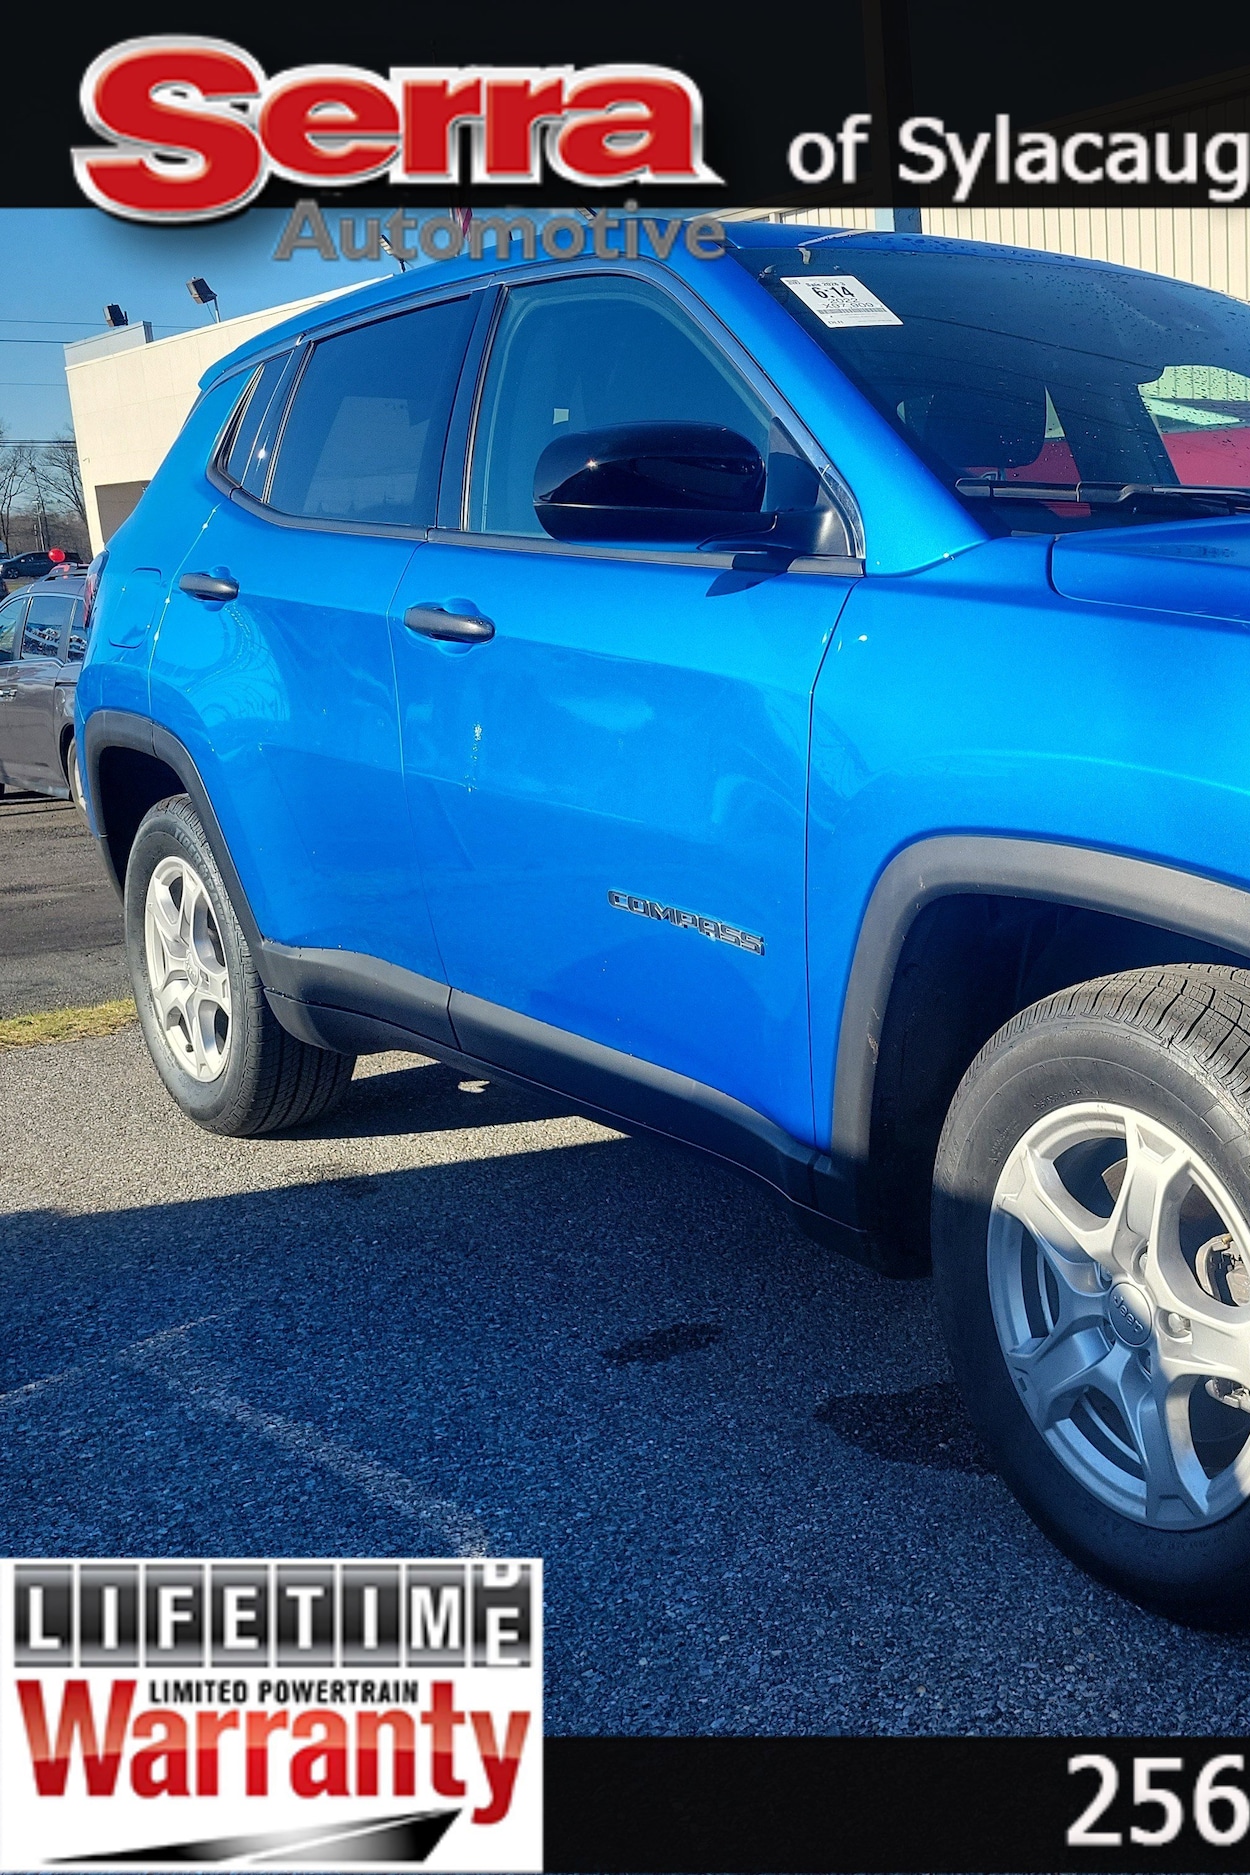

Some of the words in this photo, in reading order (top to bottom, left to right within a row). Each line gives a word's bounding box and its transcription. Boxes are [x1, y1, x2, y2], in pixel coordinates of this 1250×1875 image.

[812, 286, 855, 299] 6:14
[607, 889, 766, 957] COMPASS
[1113, 1295, 1145, 1333] Jeep
